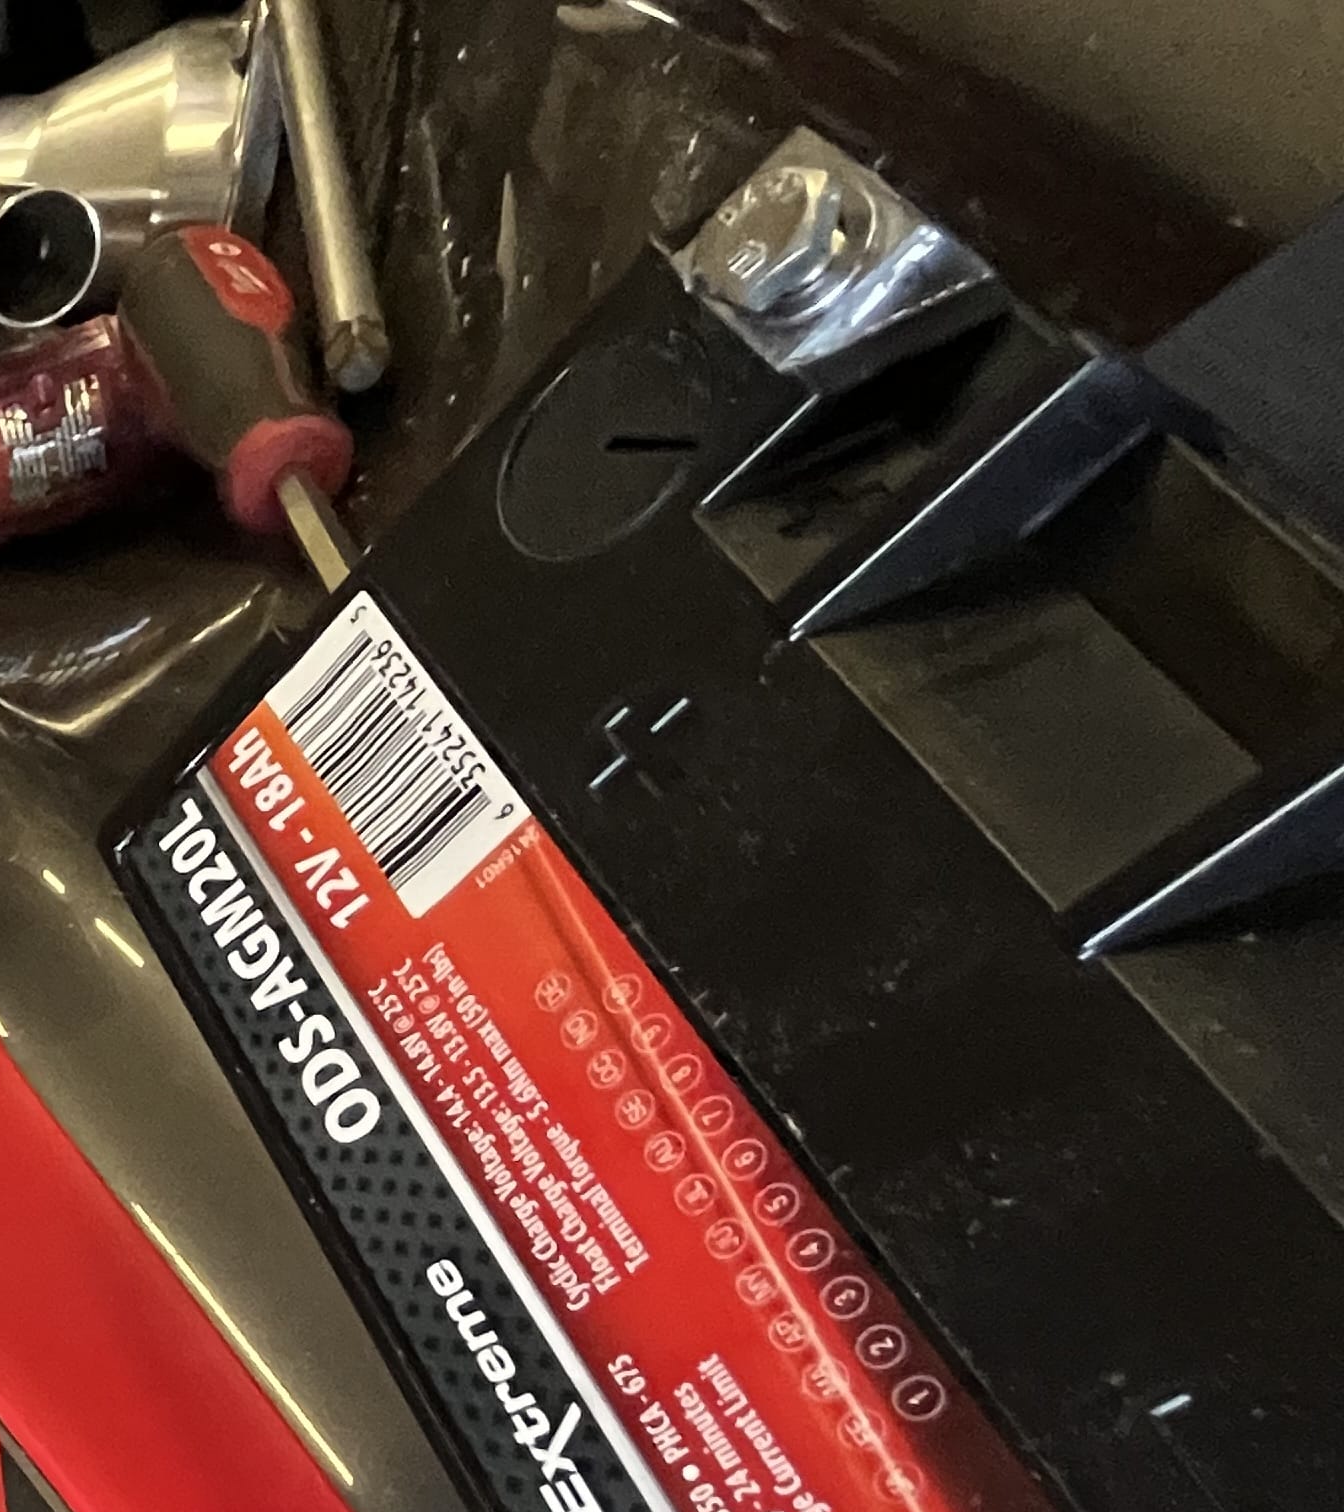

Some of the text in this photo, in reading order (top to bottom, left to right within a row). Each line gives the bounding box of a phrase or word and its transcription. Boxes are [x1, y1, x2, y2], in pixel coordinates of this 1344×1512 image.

[348, 604, 368, 625] 5
[370, 638, 428, 711] 14236
[227, 726, 306, 832] 18Ah
[493, 801, 515, 820] 6
[293, 846, 370, 929] 12V
[157, 797, 381, 1144] ODS-AGM20L
[398, 1030, 442, 1083] 14.8V
[424, 1011, 469, 1063] 13.8V
[475, 1018, 512, 1063] max
[435, 1083, 472, 1128] 14.4
[461, 1065, 499, 1109] 13.5
[462, 1119, 518, 1202] Voltage:
[493, 1106, 546, 1183] Voltage:
[545, 1121, 596, 1194] Torque
[508, 1192, 558, 1261] Charge
[536, 1172, 588, 1243] Charge
[578, 1181, 650, 1274] Terminal
[546, 1253, 591, 1311] Cyclic
[574, 1235, 621, 1295] Float
[606, 1353, 646, 1395] 675
[696, 1352, 749, 1417] Limit
[638, 1400, 690, 1464] PHCA
[672, 1381, 742, 1471] minutes
[733, 1407, 802, 1496] Current
[723, 1467, 761, 1503] 24
